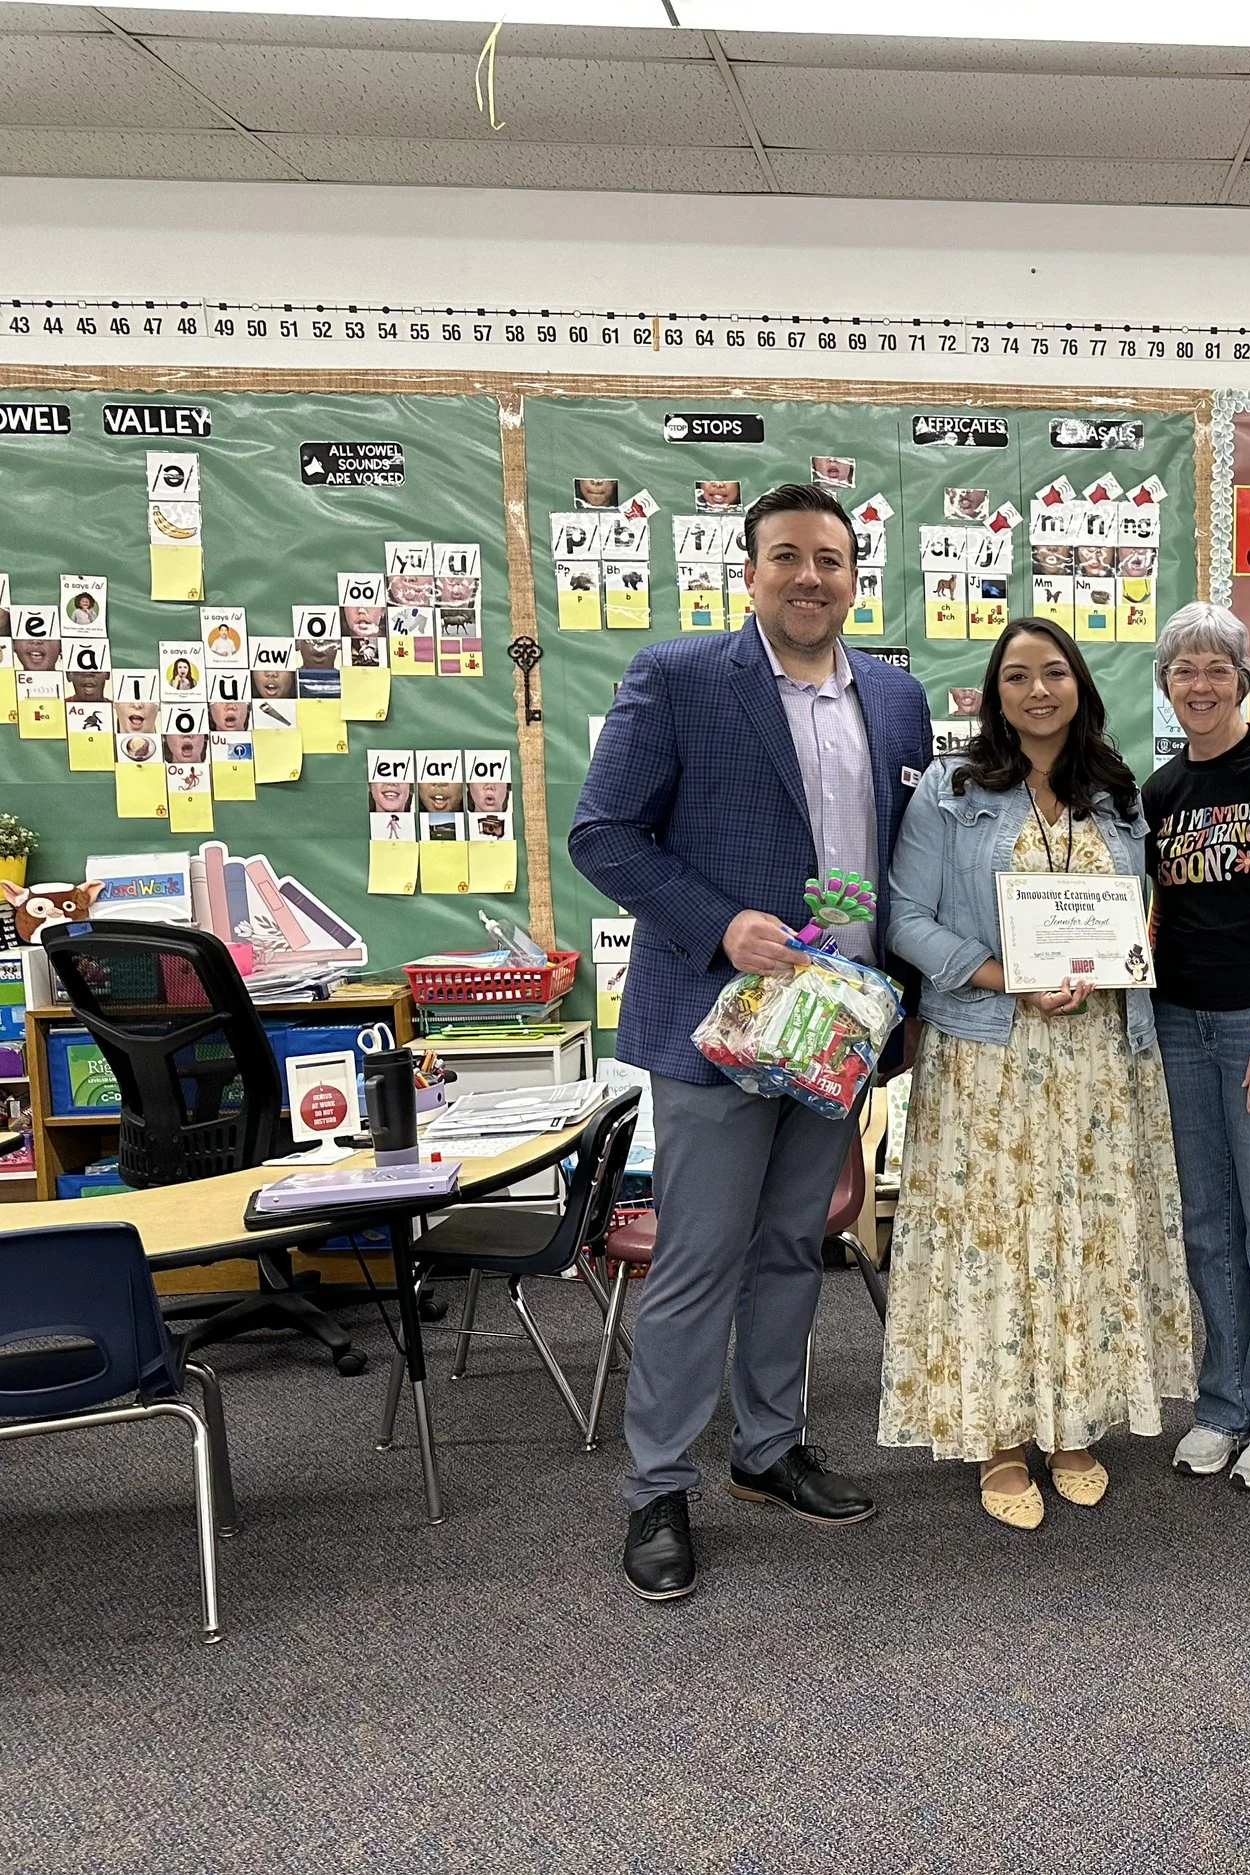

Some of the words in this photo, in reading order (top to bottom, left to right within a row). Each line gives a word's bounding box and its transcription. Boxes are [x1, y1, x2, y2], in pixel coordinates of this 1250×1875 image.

[9, 316, 30, 334] 43
[43, 317, 64, 335] 44
[76, 317, 97, 335] 45
[109, 317, 131, 335] 46
[143, 317, 163, 335] 47
[177, 317, 197, 335] 48
[214, 319, 235, 336] 49
[247, 319, 267, 337] 50
[280, 320, 298, 338] 51
[312, 321, 333, 338] 52
[345, 321, 365, 339] 53
[378, 322, 398, 340] 54
[410, 323, 430, 340] 55
[442, 323, 462, 341] 56
[473, 324, 492, 342] 57
[505, 325, 525, 342] 58
[537, 325, 557, 343] 59
[569, 326, 588, 343] 60
[602, 327, 619, 344] 61
[633, 328, 652, 345] 62
[664, 328, 683, 346] 63
[695, 329, 715, 346] 64
[726, 329, 745, 347] 65
[757, 330, 776, 347] 66
[787, 331, 806, 348] 67
[818, 332, 837, 350] 68
[848, 333, 867, 351] 69
[877, 334, 897, 351] 70
[908, 334, 926, 351] 71
[938, 335, 957, 352] 72
[971, 336, 990, 353] 73
[1001, 337, 1020, 354] 74
[1030, 338, 1049, 355] 75
[1060, 338, 1078, 356] 76
[1089, 339, 1107, 356] 77
[1118, 340, 1136, 357] 78
[1147, 341, 1165, 358] 79
[1176, 341, 1194, 359] 80
[1205, 342, 1221, 359] 81
[1233, 343, 1250, 360] 82
[104, 407, 209, 435] VALLEY
[668, 424, 687, 432] STOP
[692, 419, 743, 435] STOPS
[1077, 425, 1136, 441] NASALS
[328, 444, 354, 457] ALL
[356, 444, 402, 457] VOWEL
[338, 458, 390, 470] SOUNDS
[326, 472, 352, 484] ARE
[354, 472, 404, 485] VOICED
[606, 564, 621, 575] Bb
[679, 566, 694, 577] Tt
[969, 575, 981, 589] Jj
[1034, 578, 1053, 588] Mm
[1076, 580, 1091, 590] Nn
[18, 674, 33, 684] Ee
[68, 706, 84, 716] Aa
[211, 735, 226, 745] Uu
[168, 765, 183, 776] Oo
[1160, 844, 1238, 887] SOON?
[138, 876, 180, 896] Work
[1015, 889, 1062, 901] Innovative
[1063, 889, 1101, 902] Learning
[1101, 890, 1128, 902] Grant
[1054, 900, 1096, 913] Recipient
[1043, 914, 1082, 927] Jennifer
[312, 1092, 333, 1101] GENIUS
[311, 1102, 319, 1110] AT
[319, 1100, 336, 1109] WORK
[323, 1108, 334, 1116] NOT
[313, 1116, 337, 1126] DISTURB
